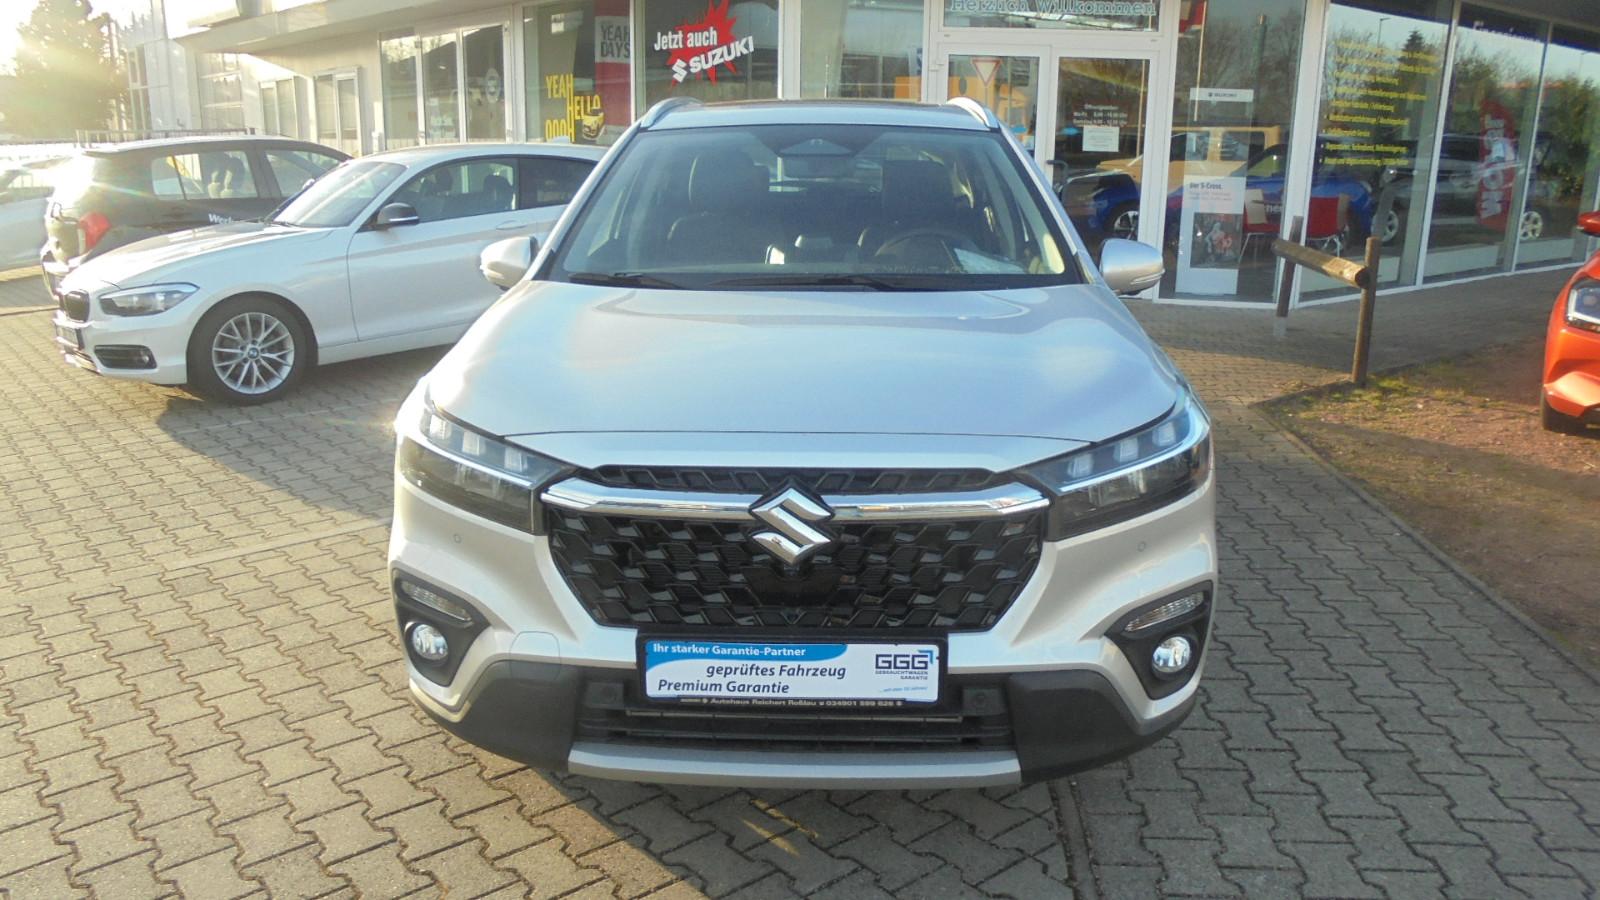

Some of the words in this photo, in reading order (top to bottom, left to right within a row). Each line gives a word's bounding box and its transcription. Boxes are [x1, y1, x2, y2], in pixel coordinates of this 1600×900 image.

[600, 25, 630, 42] YEAH
[654, 30, 683, 51] Jetzt
[687, 26, 717, 48] auch
[600, 42, 630, 58] DAYS
[689, 36, 754, 73] SUZUKI
[546, 73, 574, 98] YEAH
[653, 643, 668, 653] Ihr
[671, 643, 709, 654] starker
[712, 645, 806, 656] Garantie-Partner
[875, 654, 928, 669] GGG
[707, 664, 776, 678] geprüftes
[779, 665, 846, 680] Fahrzeug
[658, 679, 722, 692] Premium
[727, 681, 790, 694] Garantie
